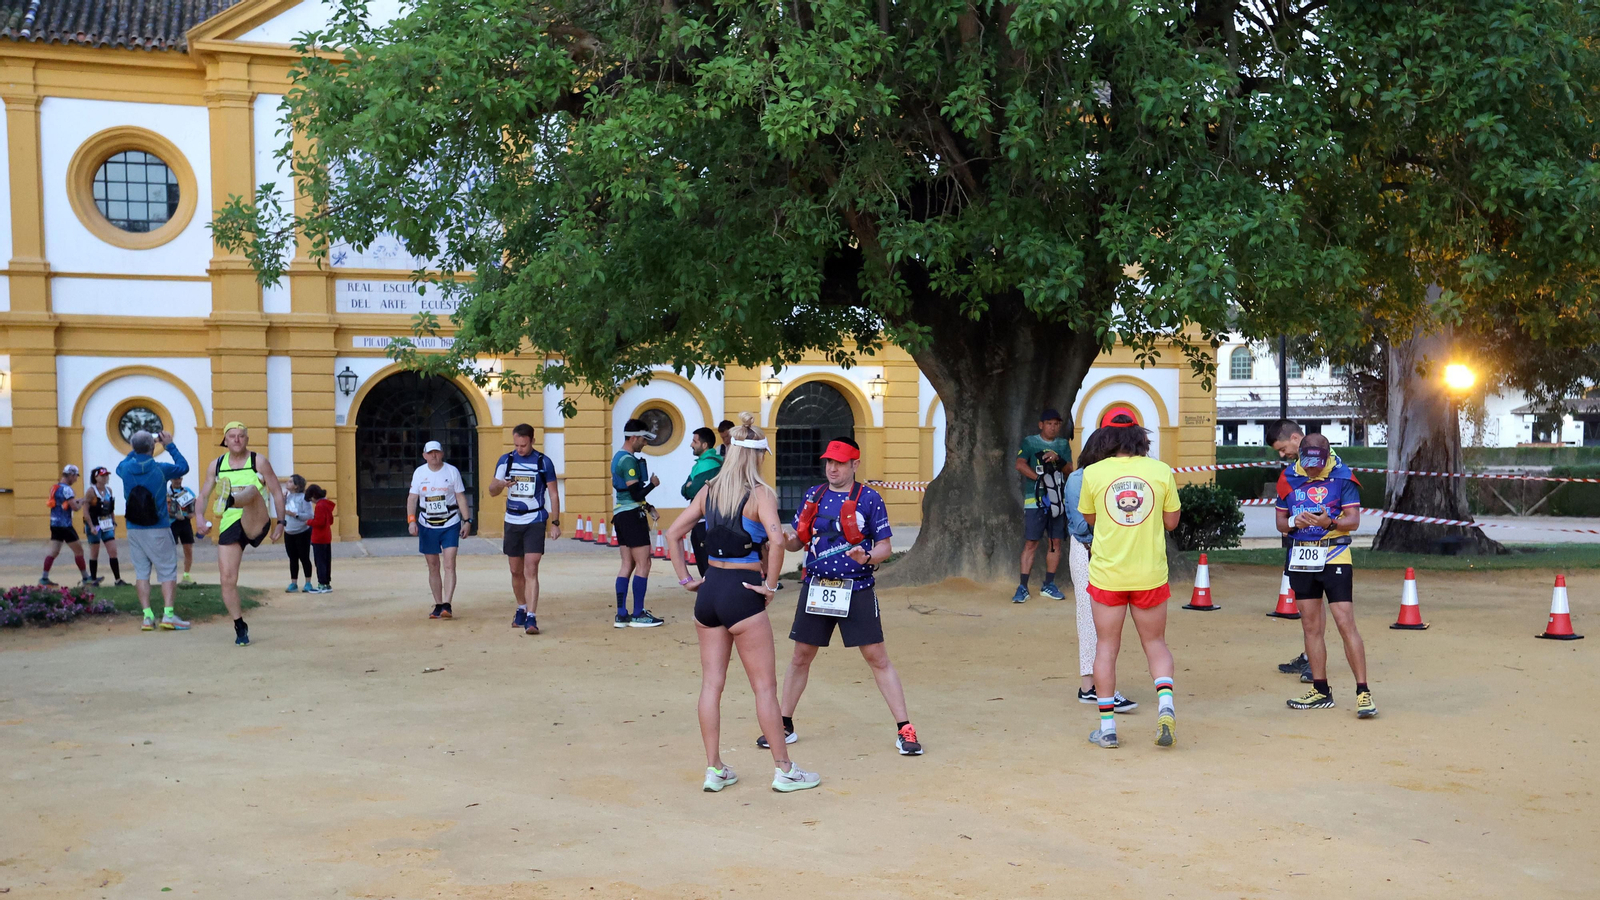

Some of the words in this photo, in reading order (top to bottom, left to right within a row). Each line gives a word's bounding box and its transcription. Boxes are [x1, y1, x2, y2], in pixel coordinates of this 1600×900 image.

[347, 282, 373, 292] REAL
[383, 283, 420, 293] ESCUEL
[351, 299, 371, 309] DEL
[380, 299, 407, 310] ARTE
[412, 338, 437, 348] LVARO
[516, 482, 529, 491] 135
[1111, 481, 1132, 493] FORREST
[1294, 488, 1306, 501] Yo
[429, 502, 442, 510] 136
[1292, 503, 1331, 517] Colomba
[1299, 548, 1319, 561] 208
[822, 589, 837, 603] 85
